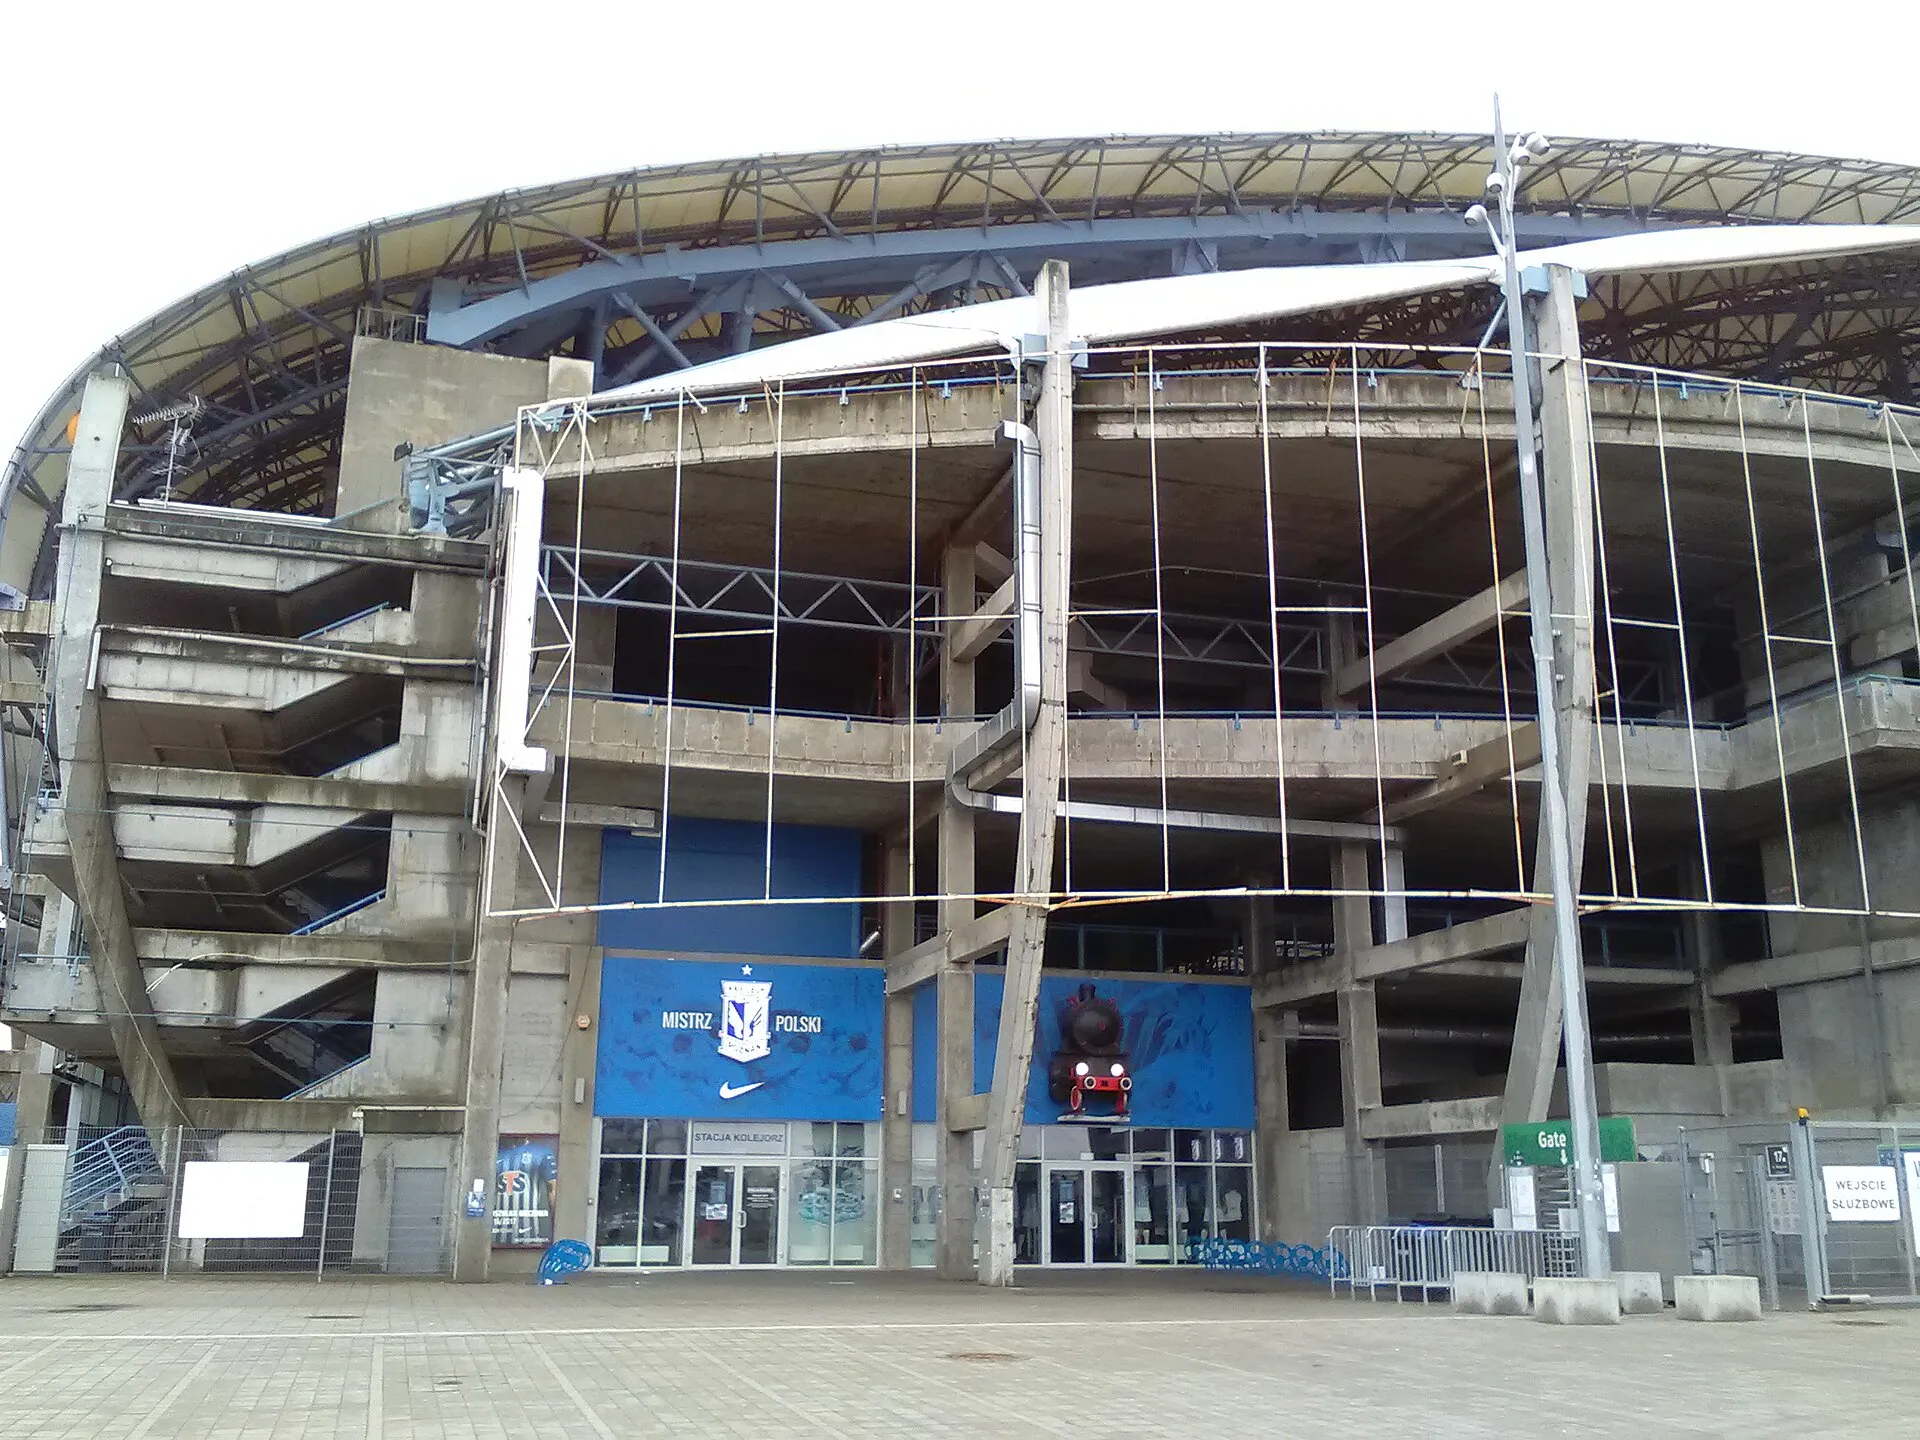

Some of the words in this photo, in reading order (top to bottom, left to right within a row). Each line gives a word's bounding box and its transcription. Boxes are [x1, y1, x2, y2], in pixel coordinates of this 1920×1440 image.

[662, 1011, 713, 1030] MISTRZ
[775, 1015, 822, 1033] POLSKI
[694, 1133, 732, 1142] STACJA
[733, 1133, 784, 1143] KOLEJORZ
[1537, 1131, 1567, 1148] Gate
[497, 1172, 526, 1193] STS
